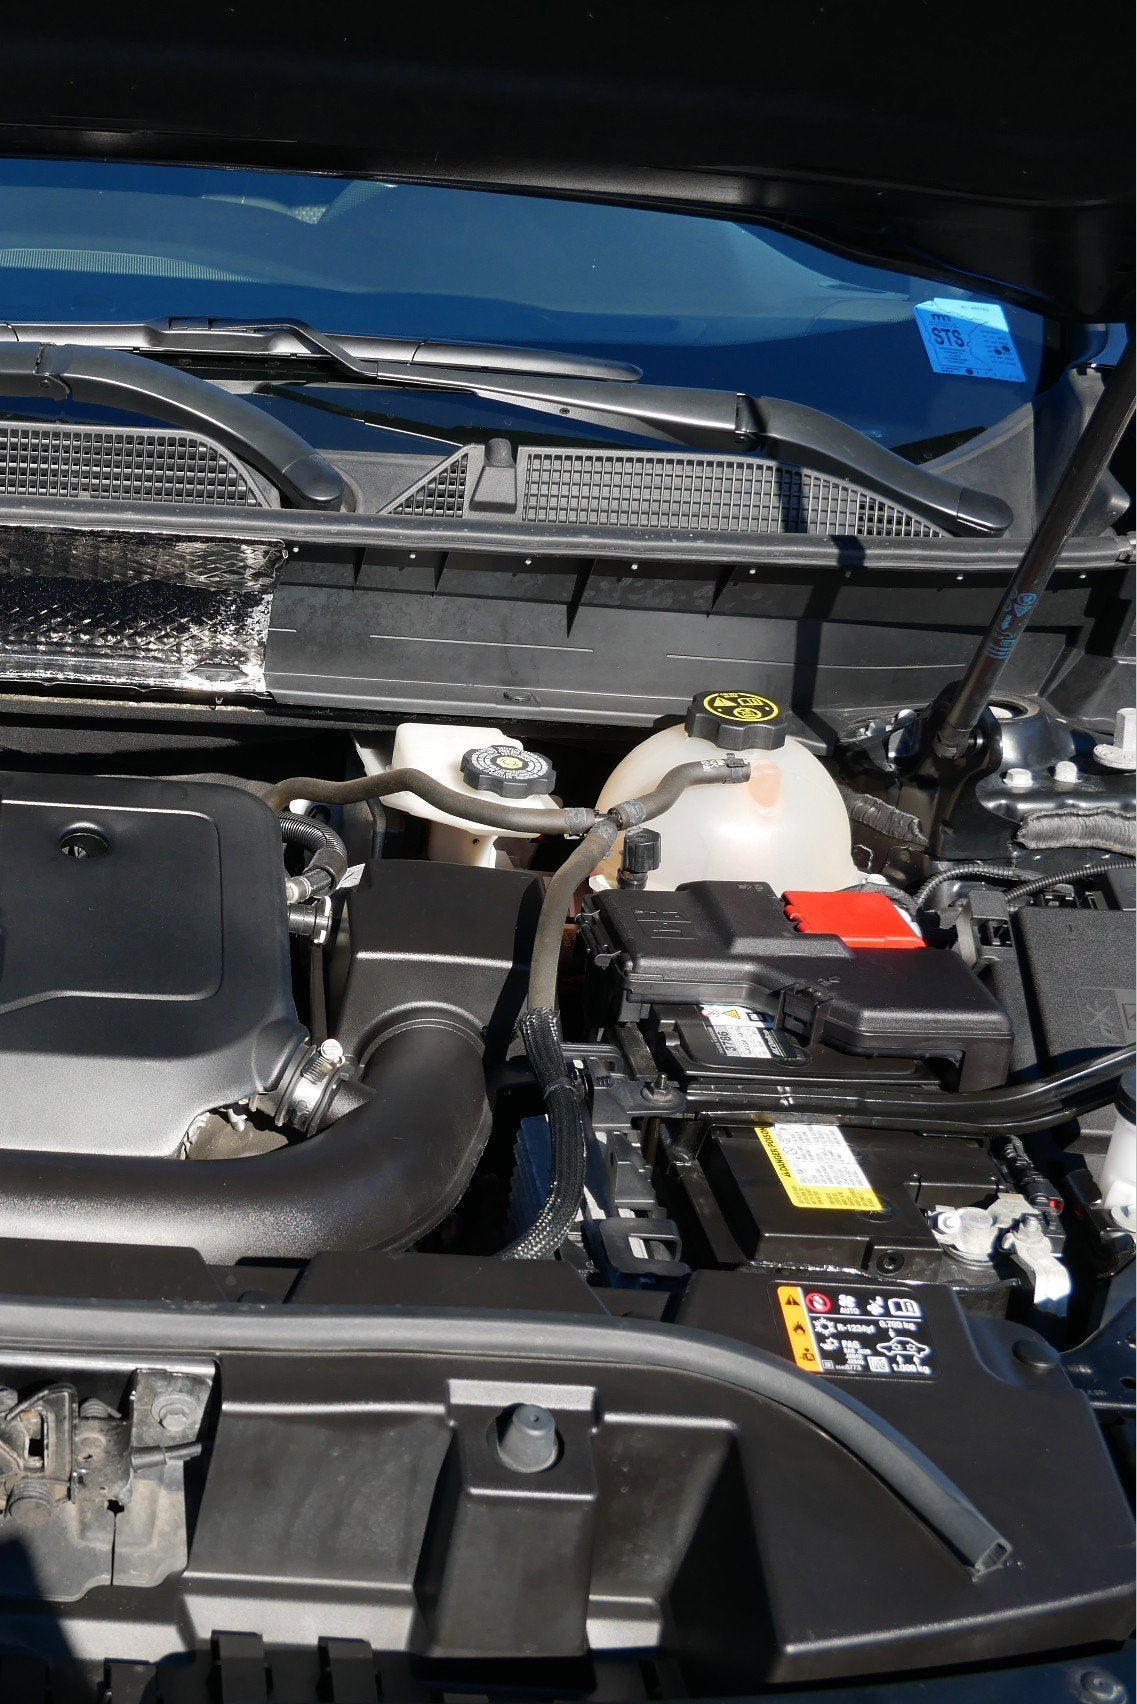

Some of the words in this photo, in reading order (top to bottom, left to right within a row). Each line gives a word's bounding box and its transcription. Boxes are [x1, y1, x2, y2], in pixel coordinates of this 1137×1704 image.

[931, 327, 965, 347] STS
[770, 1149, 788, 1172] DANGER
[840, 1307, 860, 1315] AUTO
[836, 1323, 876, 1334] R-1234yf
[903, 1321, 916, 1331] kg
[841, 1340, 861, 1349] PAG
[891, 1363, 917, 1373] 1.000
[917, 1364, 931, 1375] kg
